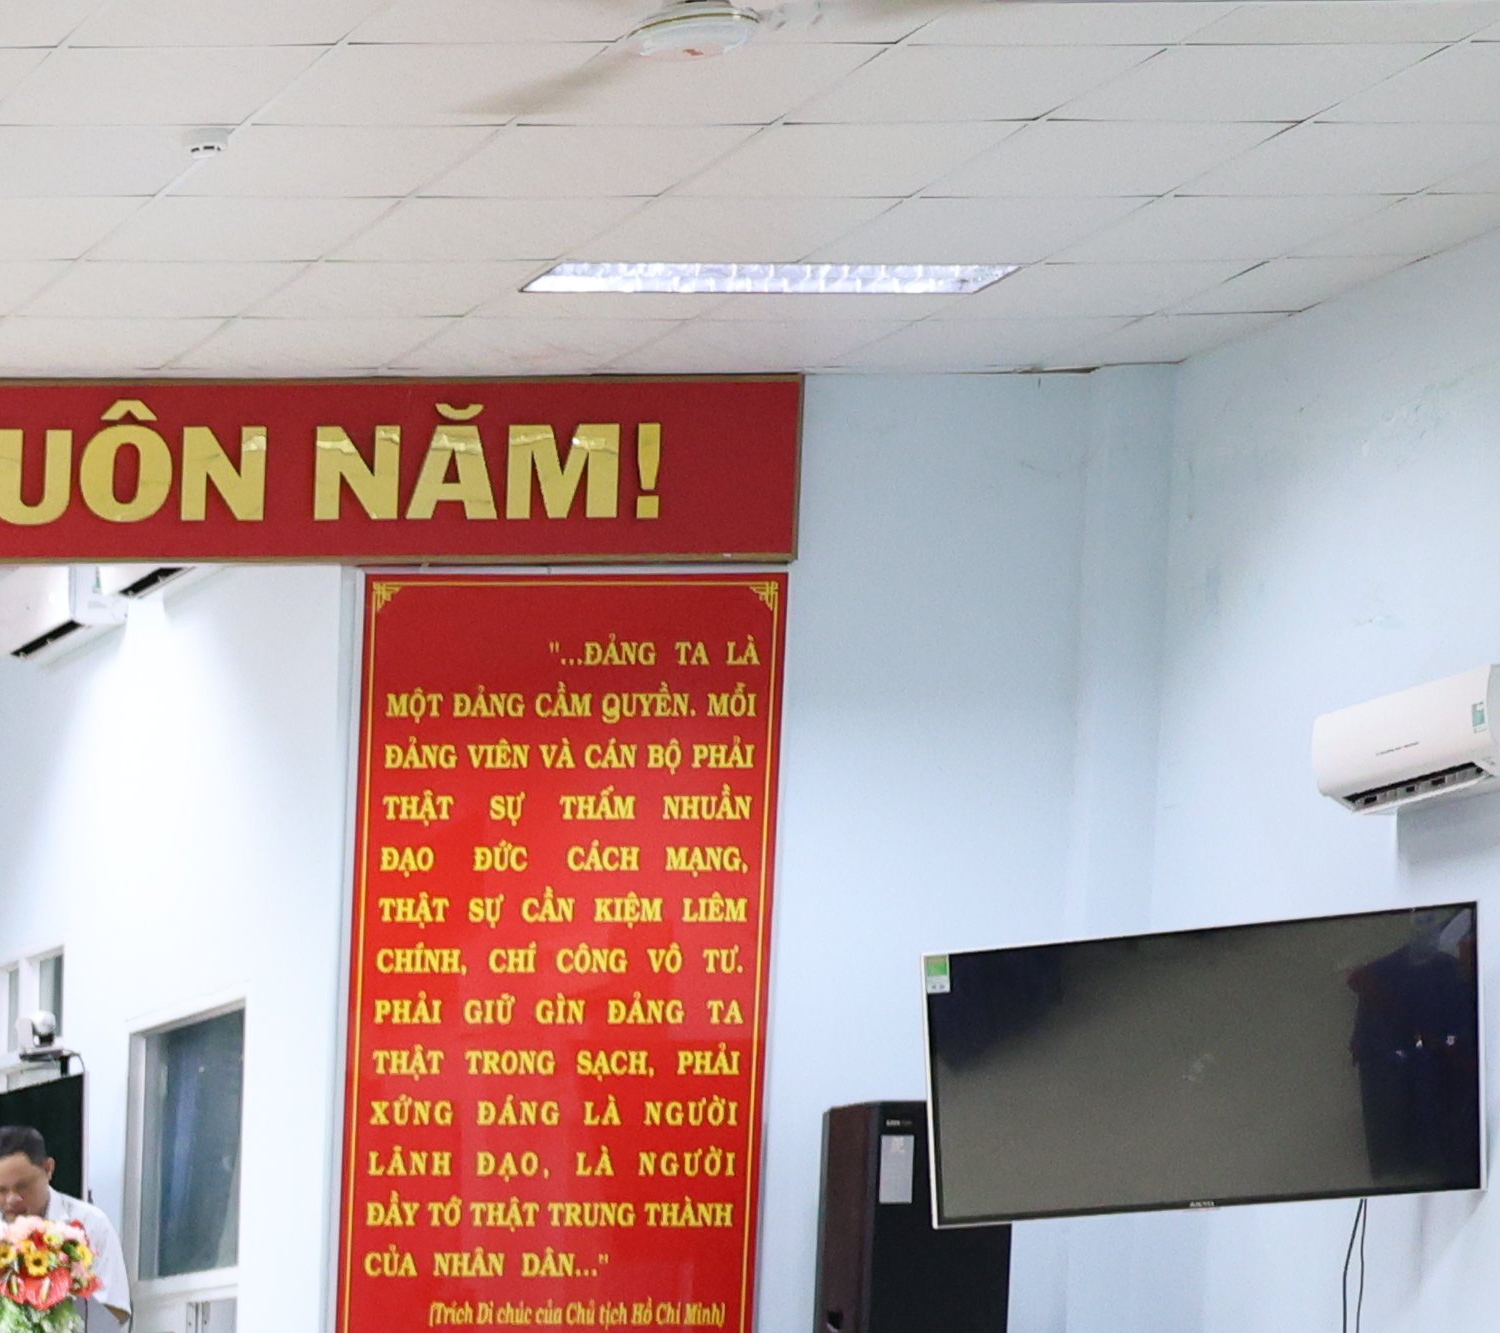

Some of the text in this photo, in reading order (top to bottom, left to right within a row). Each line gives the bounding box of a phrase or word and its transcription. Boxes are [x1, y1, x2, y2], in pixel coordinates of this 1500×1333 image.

[314, 403, 661, 521] NĂM!
[675, 641, 709, 664] TA
[726, 635, 760, 664] LÀ
[386, 681, 756, 723] MỘT ĐẢNG CẦM QUYỀN. MỖI
[384, 736, 754, 774] ĐẢNG VIÊN VÀ CÁN BỘ PHẢI
[383, 783, 752, 825] THẬT SỰ THẤM NHUẦN
[380, 839, 748, 877] ĐẠO ĐỨC CÁCH MẠNG,
[378, 886, 747, 928] THẬT SỰ CẦN KIỆM LIÊM
[376, 941, 743, 974] CHÍNH, CHÍ CÔNG VÔ TƯ.
[374, 991, 743, 1024] PHẢI GIỮ GÌN ĐẢNG TA
[372, 1042, 740, 1080] THẬT TRONG SẠCH, PHẢI
[369, 1094, 737, 1125] XỨNG ĐÁNG LÀ NGƯỜI
[476, 1151, 549, 1181] ĐẠO,
[575, 1146, 613, 1175] LÀ
[639, 1146, 735, 1176] NGƯỜI
[366, 1191, 420, 1225] ĐẦY
[469, 1196, 539, 1231] THẬT
[547, 1202, 635, 1226] TRUNG
[644, 1197, 732, 1226] THÀNH
[364, 1245, 417, 1276] CỦA
[433, 1247, 505, 1277] NHÂN
